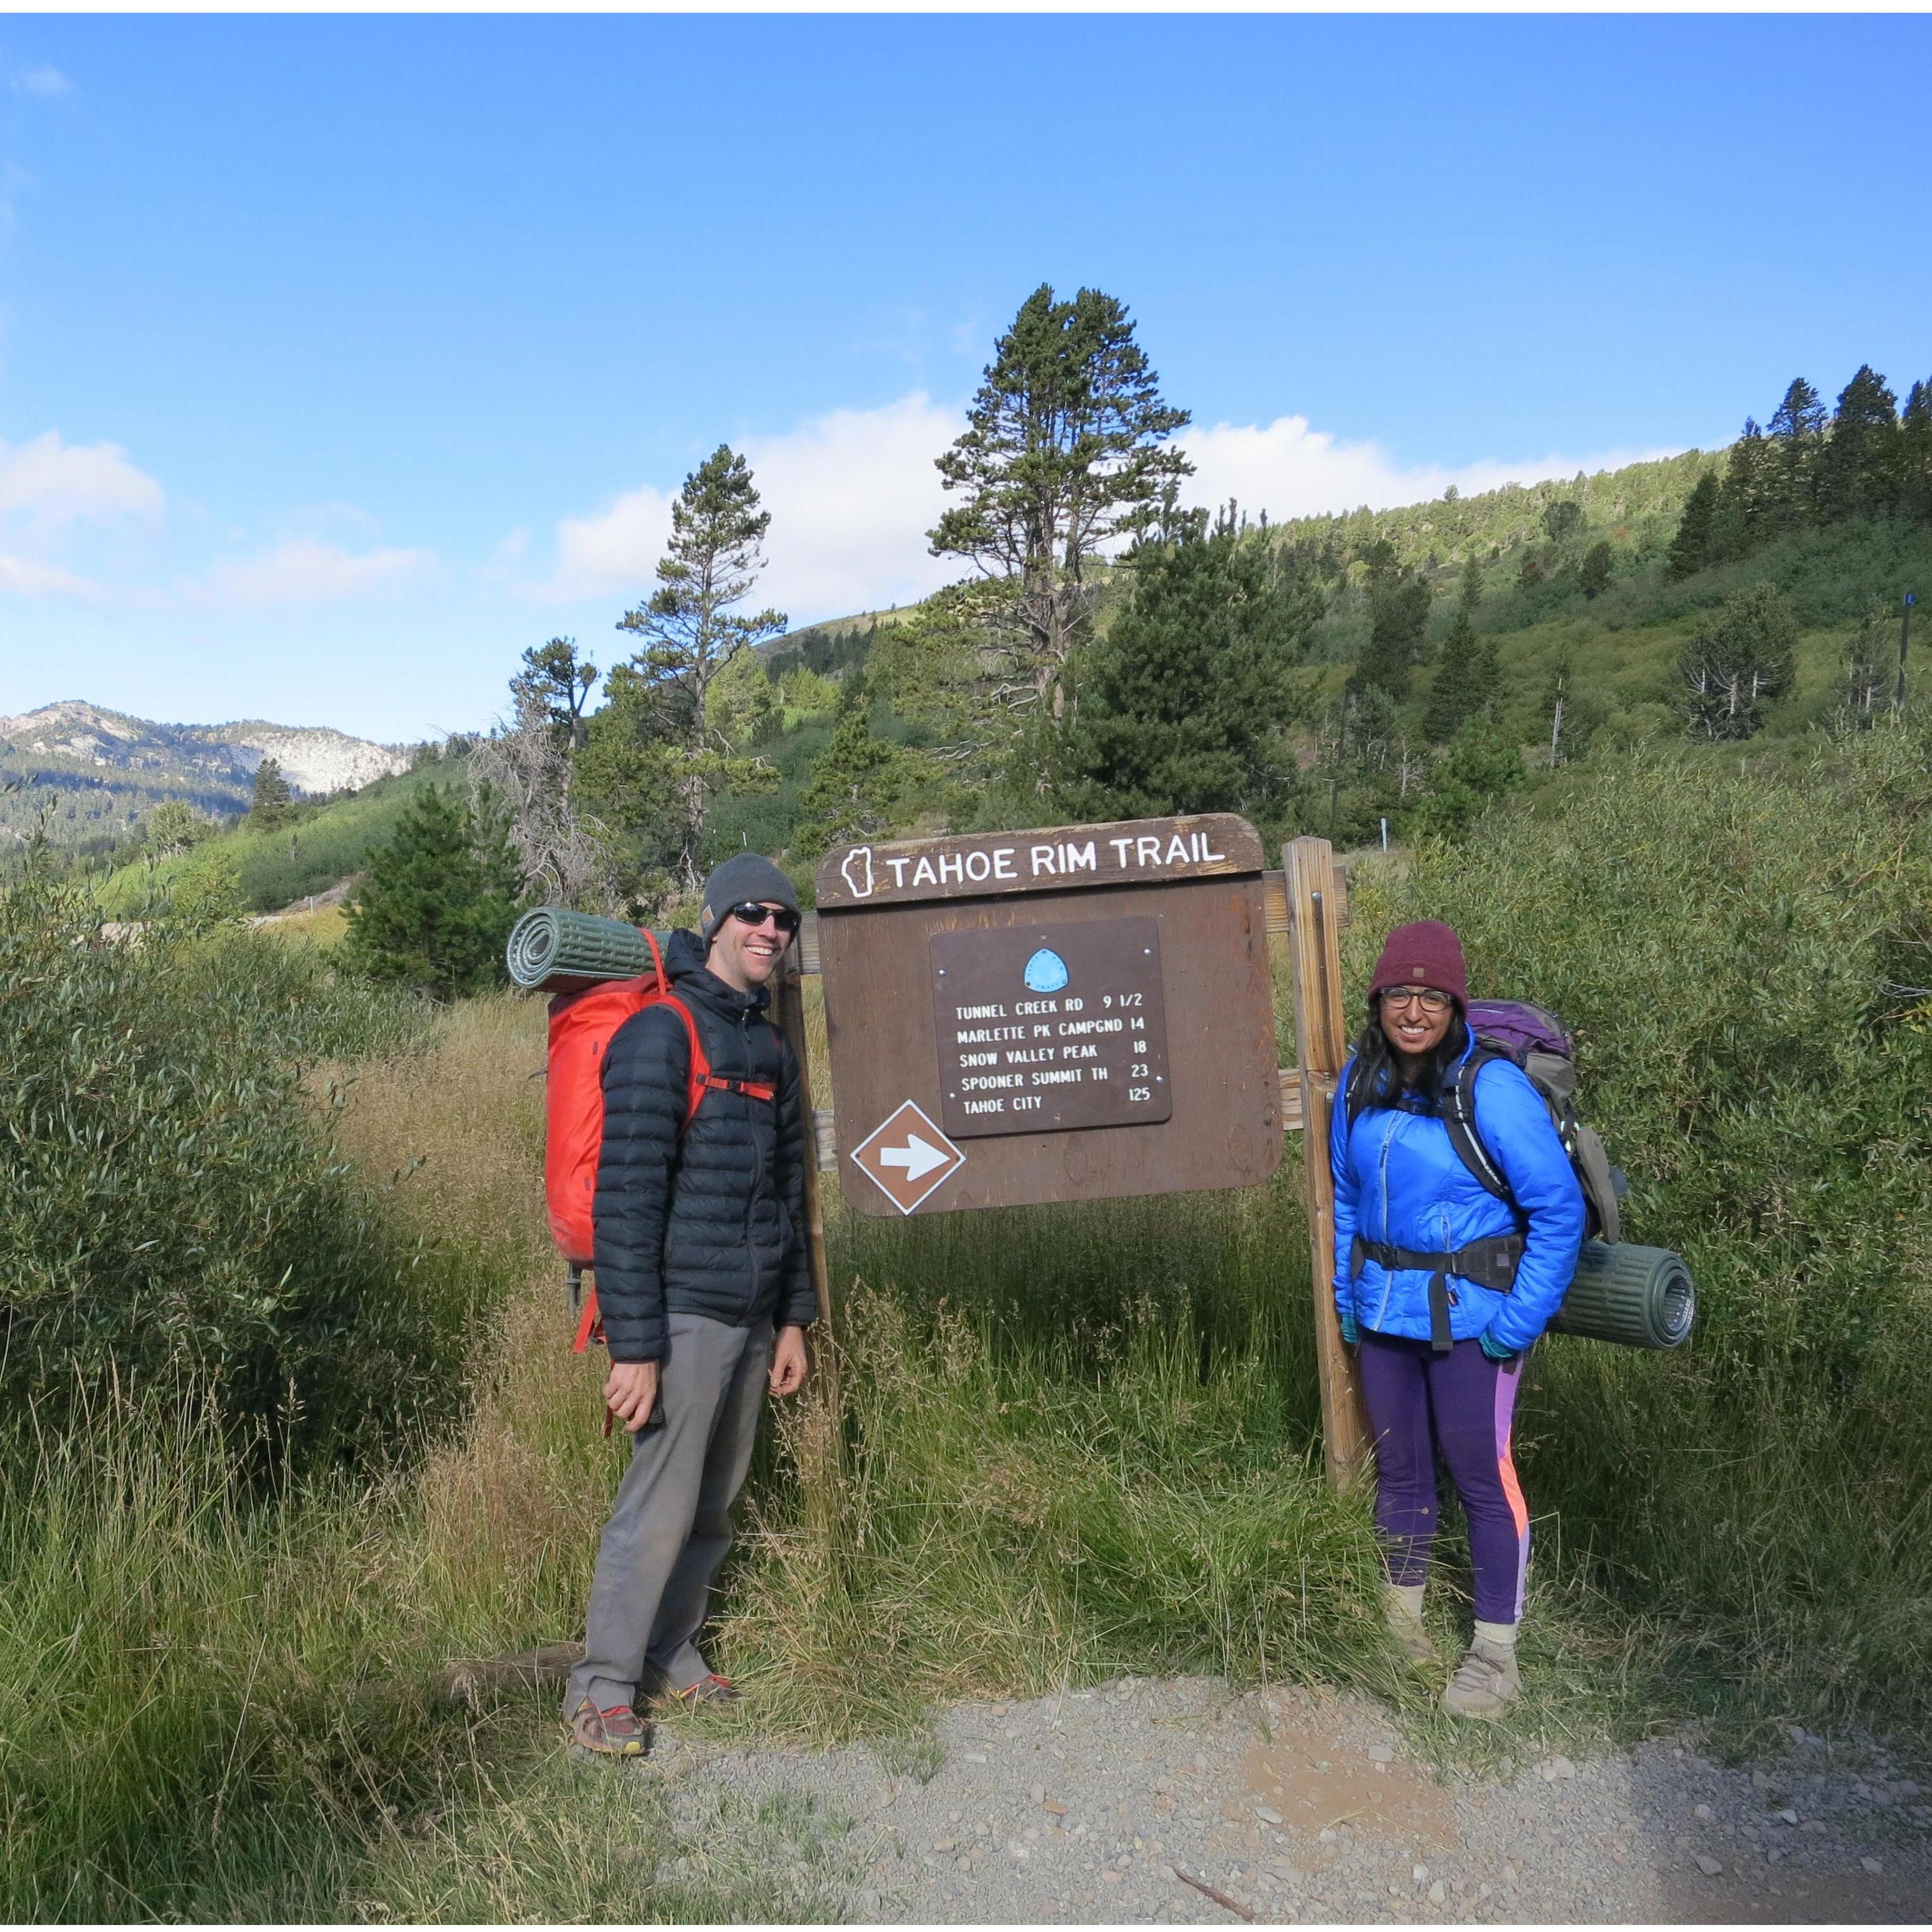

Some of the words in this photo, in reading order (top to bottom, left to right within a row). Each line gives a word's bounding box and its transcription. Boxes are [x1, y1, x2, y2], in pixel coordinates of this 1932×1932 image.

[885, 848, 1018, 888] TAHOE
[1031, 841, 1096, 876] RIM
[1109, 832, 1226, 868] TRAIL
[955, 1004, 1008, 1020] TUNNEL
[1015, 999, 1058, 1016] CREEK
[1064, 998, 1084, 1012] RD
[1103, 995, 1112, 1008] 9
[1120, 992, 1143, 1007] 1/2
[957, 1026, 1026, 1044] MARLETTE
[1033, 1024, 1051, 1038] PK
[1058, 1018, 1123, 1036] CAMPGND
[1130, 1017, 1145, 1030] 14
[959, 1052, 998, 1068] SNOW
[1006, 1047, 1055, 1064] VALLEY
[1063, 1044, 1098, 1059] PEAK
[1133, 1040, 1147, 1054] 18
[961, 1073, 1024, 1091] SPOONER
[1031, 1068, 1082, 1086] SUMMIT
[1091, 1067, 1108, 1080] TH
[1131, 1063, 1149, 1078] 23
[963, 1098, 1005, 1114] TAHOE
[1012, 1096, 1042, 1111] CITY
[1129, 1087, 1151, 1101] 125
